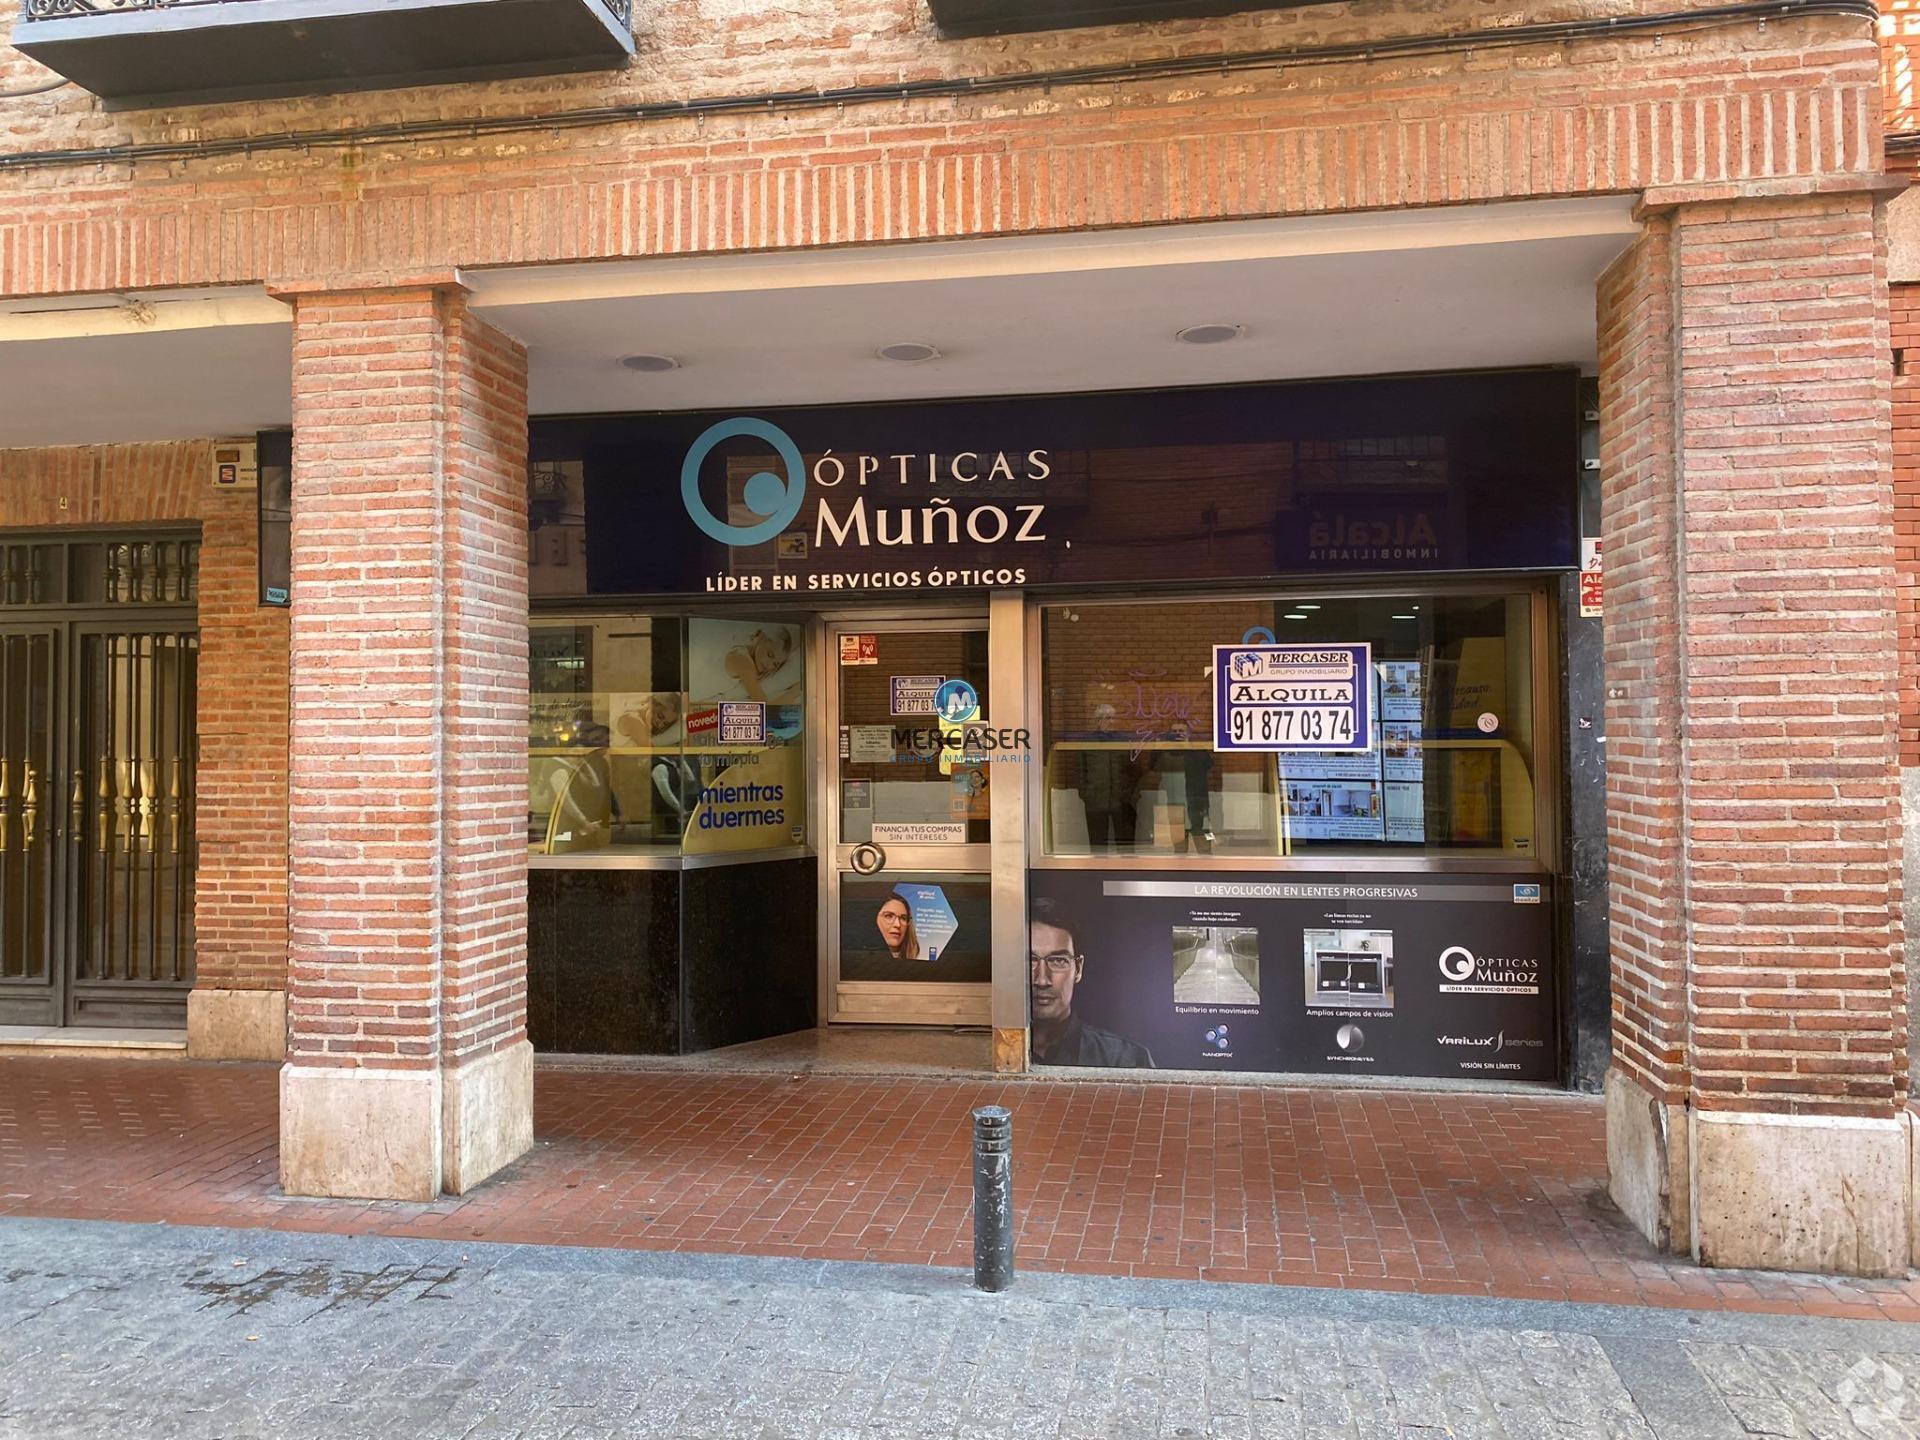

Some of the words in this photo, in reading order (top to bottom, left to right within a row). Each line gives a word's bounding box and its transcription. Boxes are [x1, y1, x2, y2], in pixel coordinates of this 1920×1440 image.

[813, 448, 1050, 487] ÓPTICAS
[815, 496, 1047, 547] Muñoz
[706, 571, 763, 592] LÍDER
[772, 575, 797, 590] EN
[808, 571, 922, 590] SERVICIOS
[927, 566, 1026, 587] ÓPTICOS
[1269, 653, 1349, 664] MERCASER
[897, 690, 936, 698] ALQUIL
[1233, 686, 1350, 702] ALQUILA
[1233, 711, 1253, 741] 91
[1261, 711, 1294, 741] 877
[1300, 711, 1322, 741] 03
[1329, 710, 1351, 741] 74
[733, 726, 744, 739] 877
[699, 781, 784, 805] mientras
[699, 806, 785, 830] duermes
[875, 825, 909, 833] FINANCIA
[910, 825, 925, 833] TUS
[926, 825, 962, 833] COMPRAS
[889, 833, 902, 841] SIN
[905, 833, 948, 841] INTERESES
[1194, 885, 1208, 895] LA
[1211, 884, 1280, 896] REVOLUCIÓN
[1283, 886, 1298, 896] EN
[1301, 886, 1341, 897] LENTES
[1343, 887, 1418, 898] PROGRESIVAS
[1476, 955, 1538, 968] ÓPTICAS
[1476, 968, 1538, 983] Muñoz
[1175, 1006, 1208, 1014] Equilibrio
[1218, 1007, 1260, 1015] movimiento
[1306, 1009, 1334, 1018] Amplios
[1335, 1010, 1361, 1018] campos
[1362, 1009, 1372, 1017] de
[1373, 1009, 1393, 1018] visión
[1504, 1038, 1544, 1047] series
[1460, 1061, 1483, 1069] VISIÓN
[1484, 1062, 1494, 1070] SIN
[1496, 1061, 1521, 1070] LÍMITES
